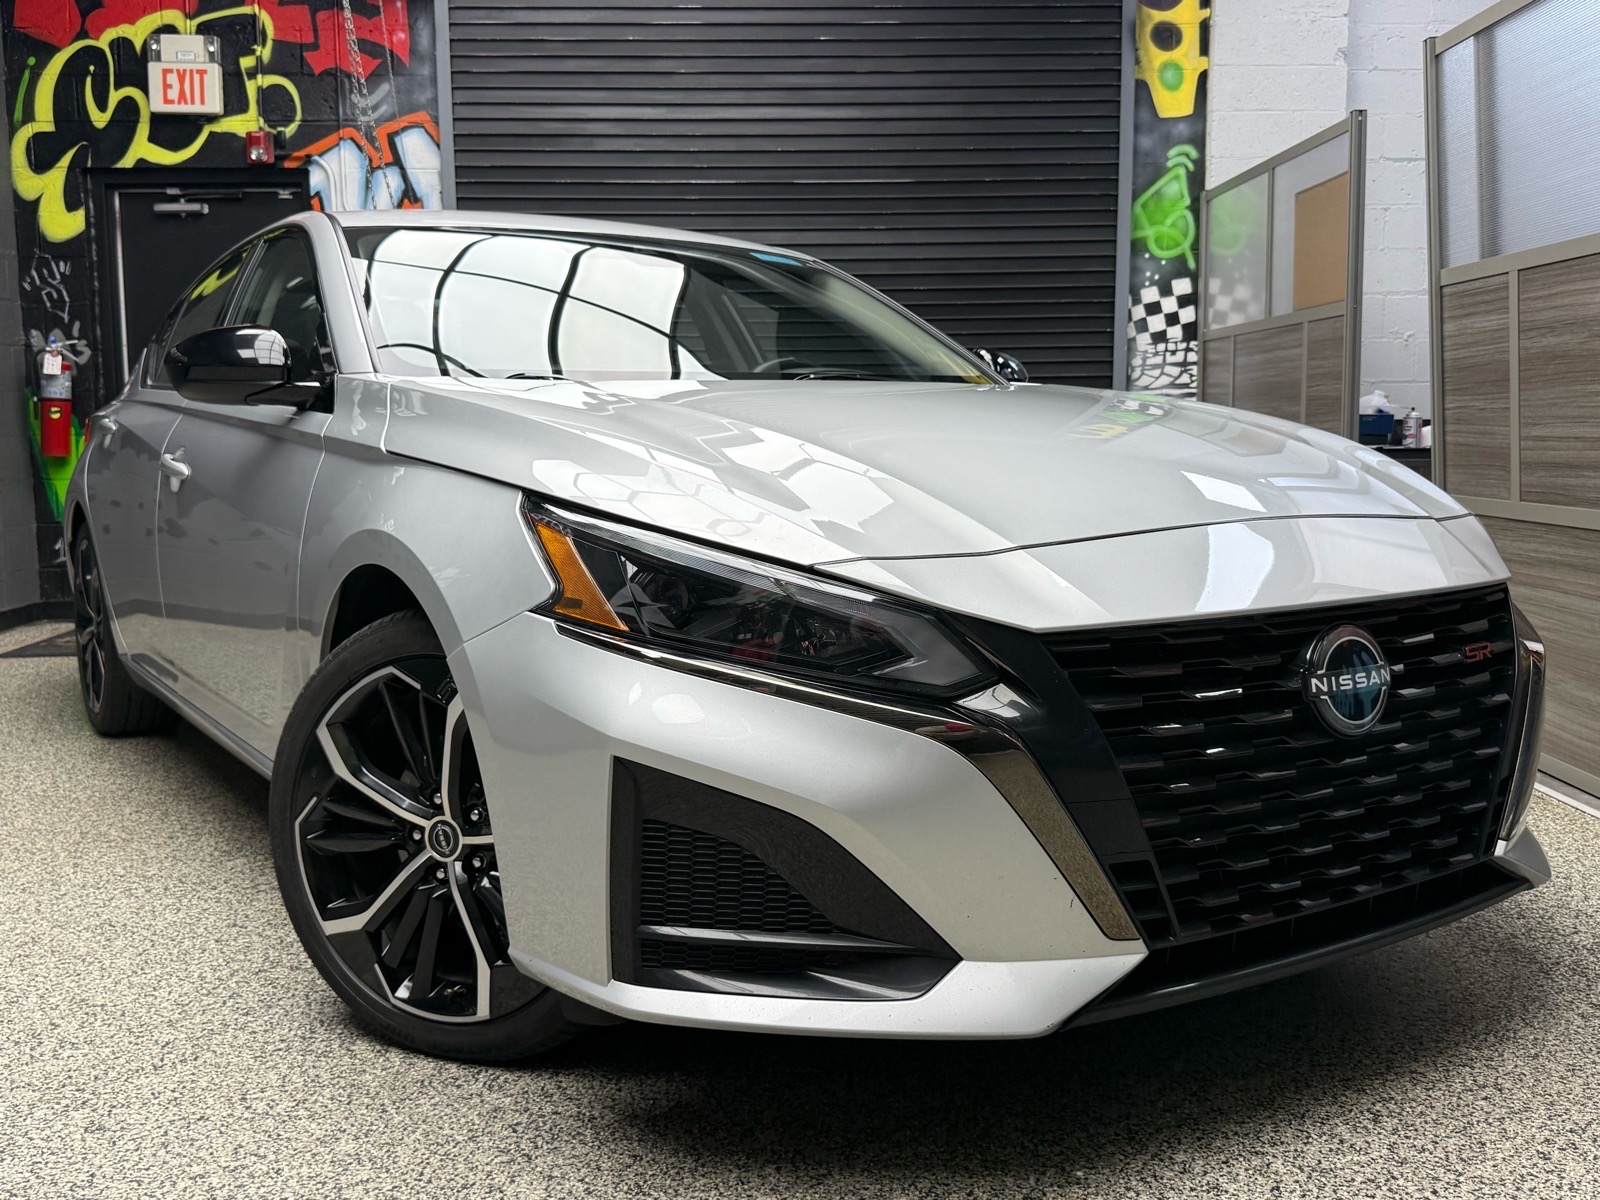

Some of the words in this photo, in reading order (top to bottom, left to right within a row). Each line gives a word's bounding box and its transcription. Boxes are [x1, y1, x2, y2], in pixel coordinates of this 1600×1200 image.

[161, 68, 208, 106] EXIT
[1465, 641, 1492, 663] SR
[1310, 667, 1390, 693] NISSAN
